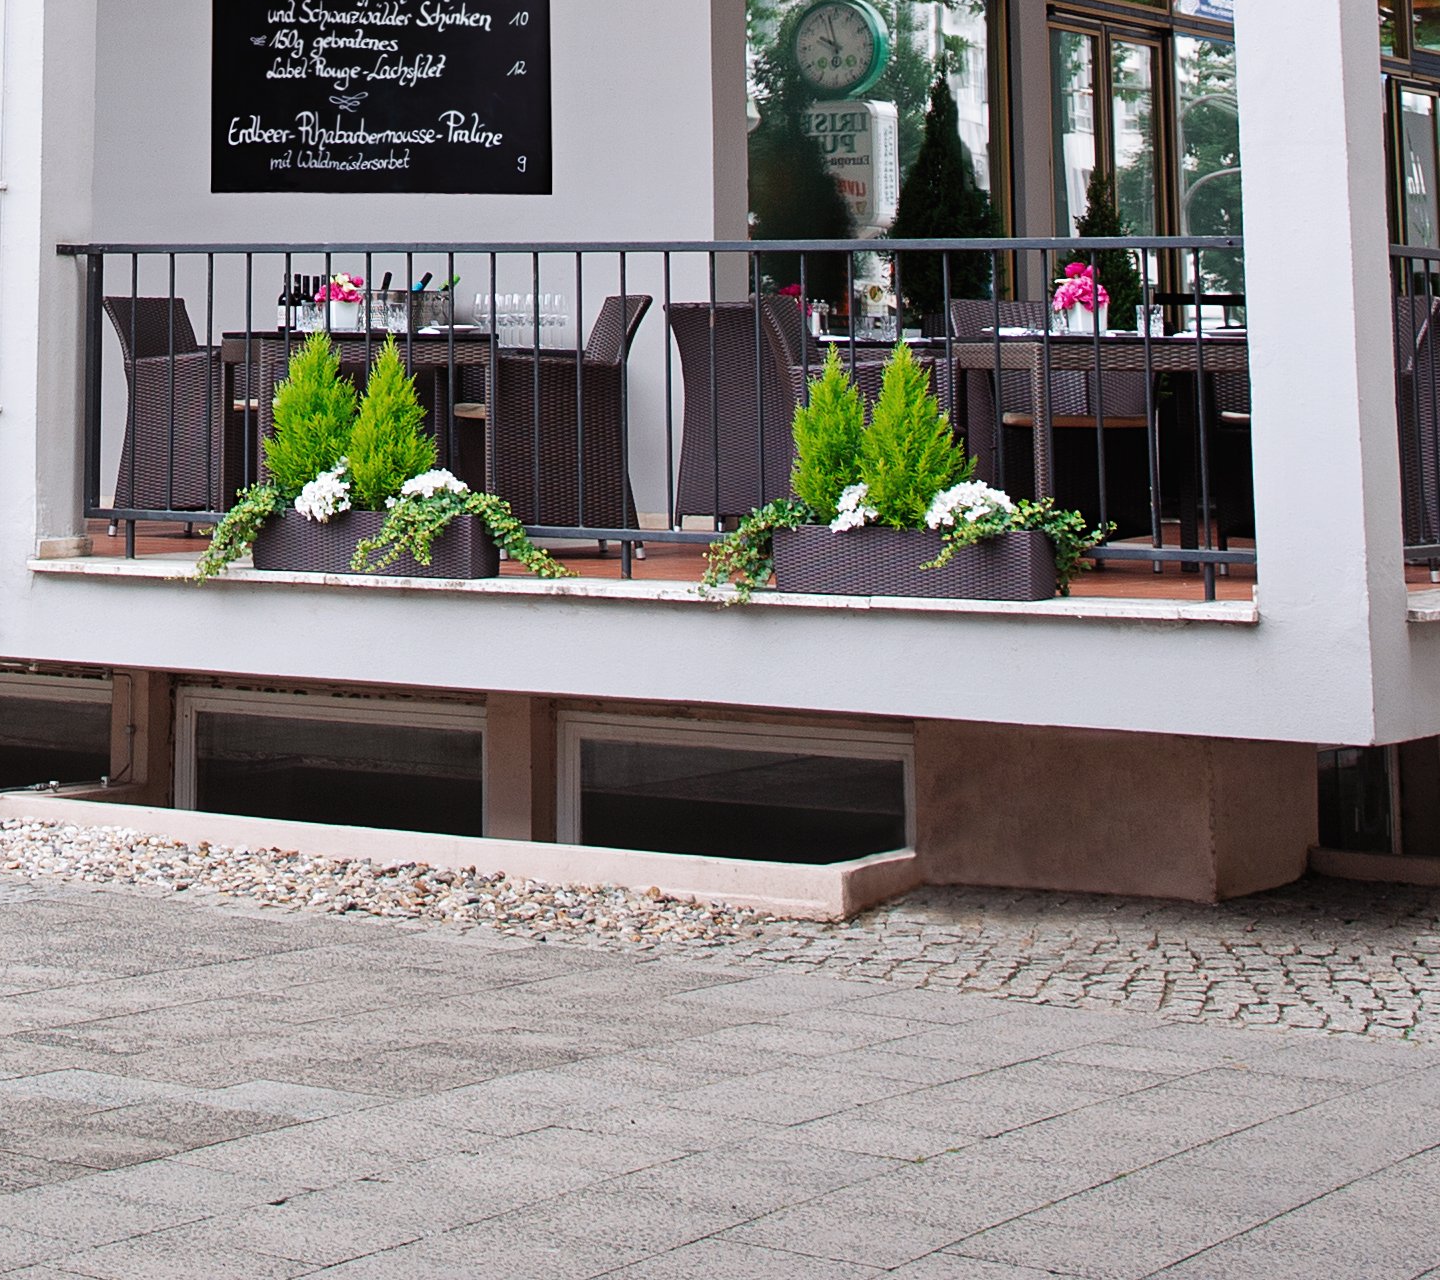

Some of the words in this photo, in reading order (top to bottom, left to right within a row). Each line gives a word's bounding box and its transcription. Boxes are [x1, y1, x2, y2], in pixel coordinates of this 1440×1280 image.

[267, 0, 296, 24] und
[299, 0, 412, 32] Schwarzwälder
[416, 1, 492, 32] Schinken
[509, 12, 529, 26] 10
[269, 29, 304, 57] 150g
[310, 28, 399, 59] gebratenes
[266, 54, 446, 90] Label-Rouge-Lachsfilet
[506, 61, 527, 77] 12
[228, 110, 503, 150] Erdbeer-Rhabarbermousse-Praline
[270, 150, 292, 170] mit
[297, 148, 410, 172] Waldmeistersorbet
[517, 155, 527, 172] 9
